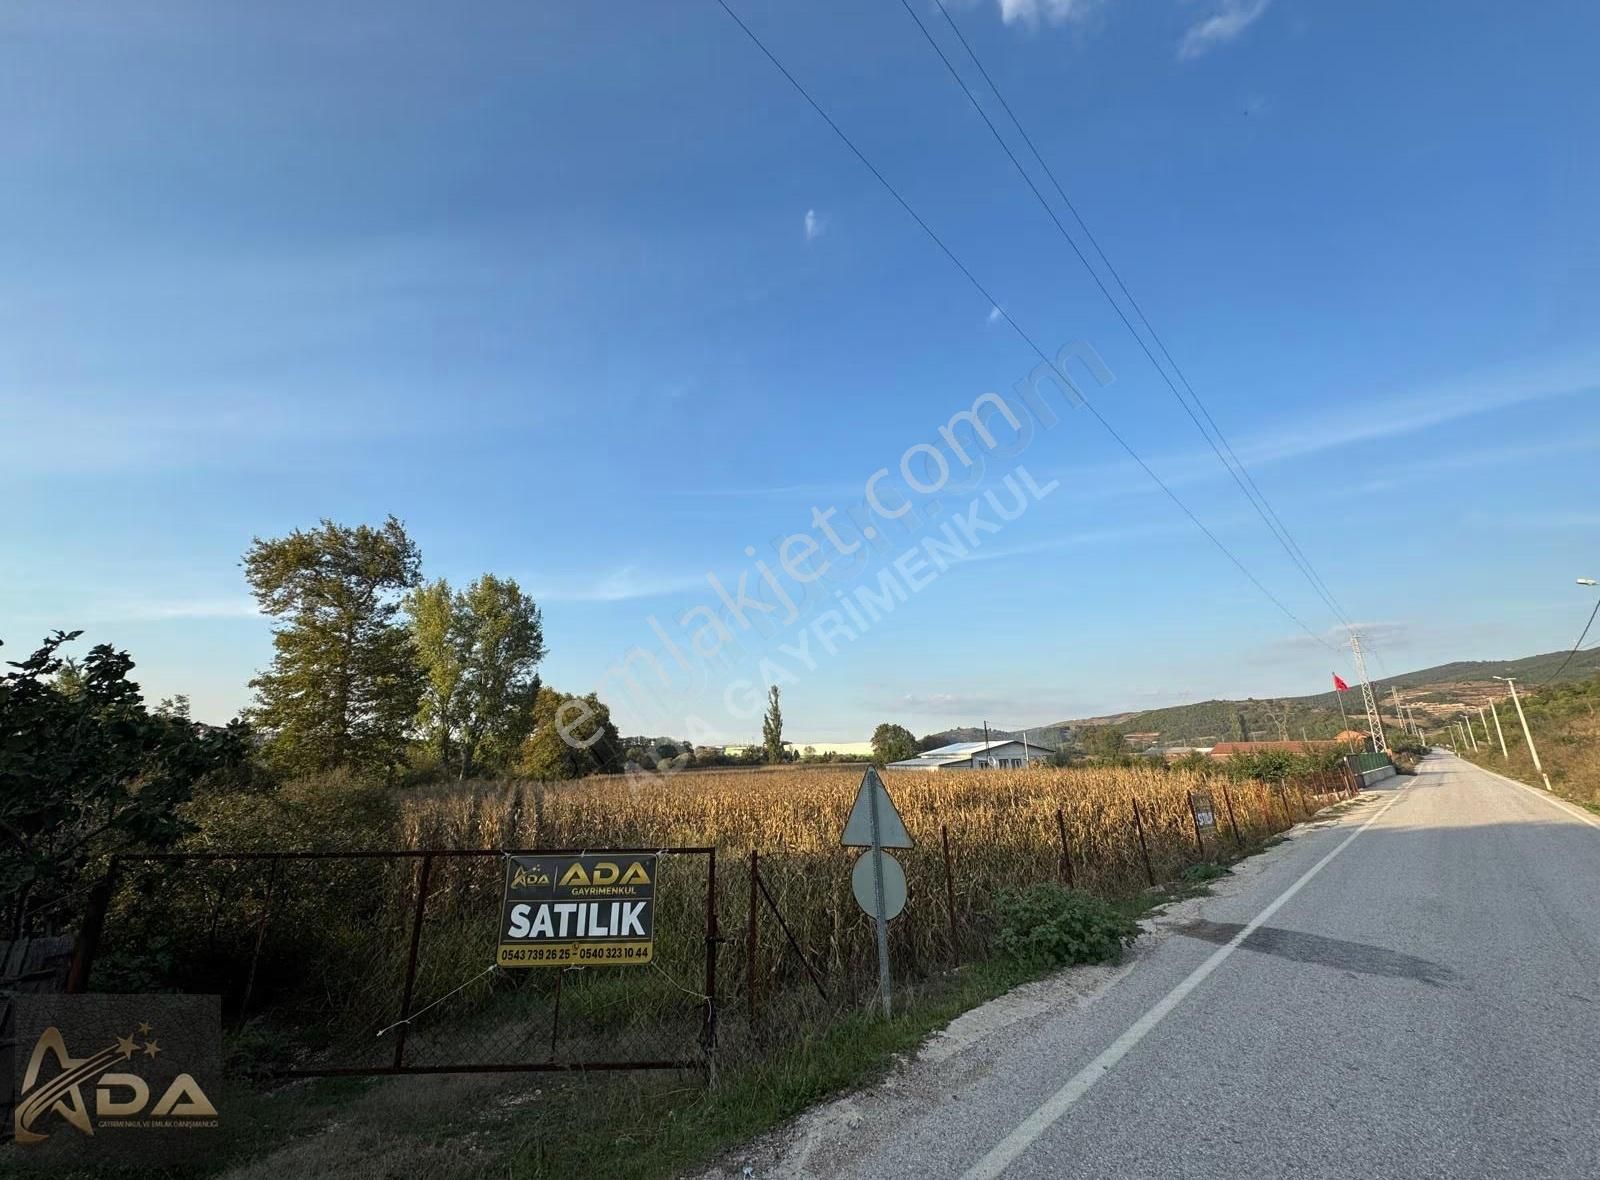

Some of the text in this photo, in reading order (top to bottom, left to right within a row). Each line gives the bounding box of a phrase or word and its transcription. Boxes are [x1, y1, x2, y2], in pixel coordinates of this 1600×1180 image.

[558, 860, 651, 886] ADA
[571, 887, 637, 896] GAYRİMENKUL
[507, 901, 647, 938] SATILIK
[502, 949, 526, 961] 0543
[527, 949, 545, 960] 739
[545, 949, 557, 960] 26
[558, 949, 570, 960] 25
[579, 948, 603, 959] 0540
[605, 948, 622, 958] 323
[624, 947, 634, 958] 10
[635, 947, 649, 958] 44
